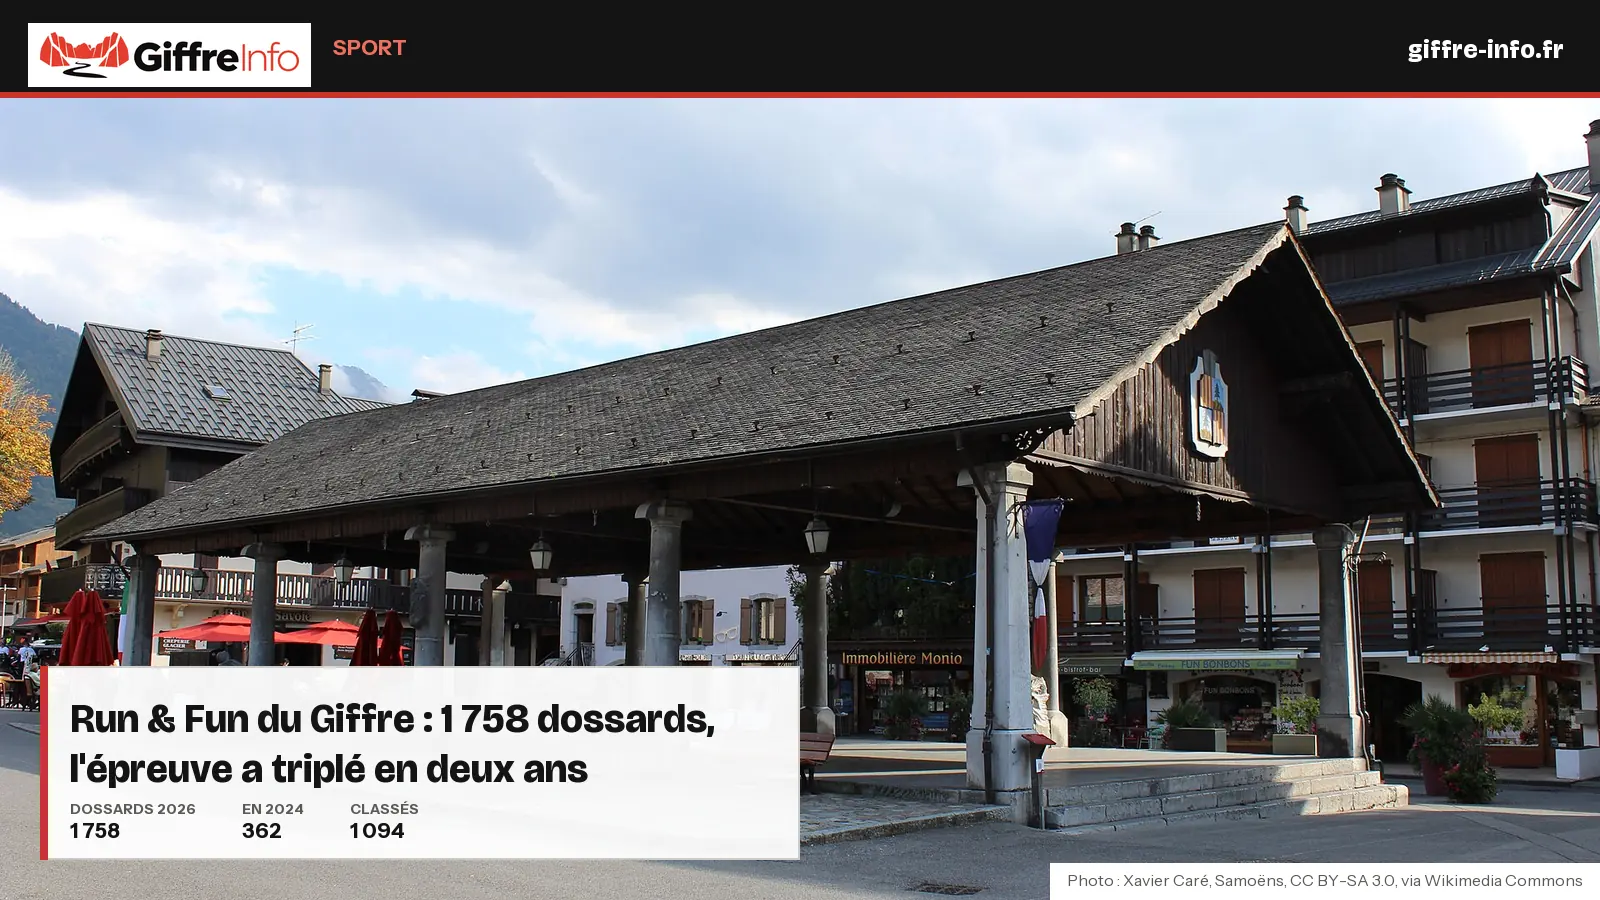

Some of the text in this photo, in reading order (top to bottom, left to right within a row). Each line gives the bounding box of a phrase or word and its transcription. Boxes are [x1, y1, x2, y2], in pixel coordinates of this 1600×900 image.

[842, 651, 963, 665] Immobilière Monio
[1181, 659, 1200, 668] FUN
[1203, 658, 1250, 668] BONBONS
[1203, 686, 1255, 694] FUN BONBONS
